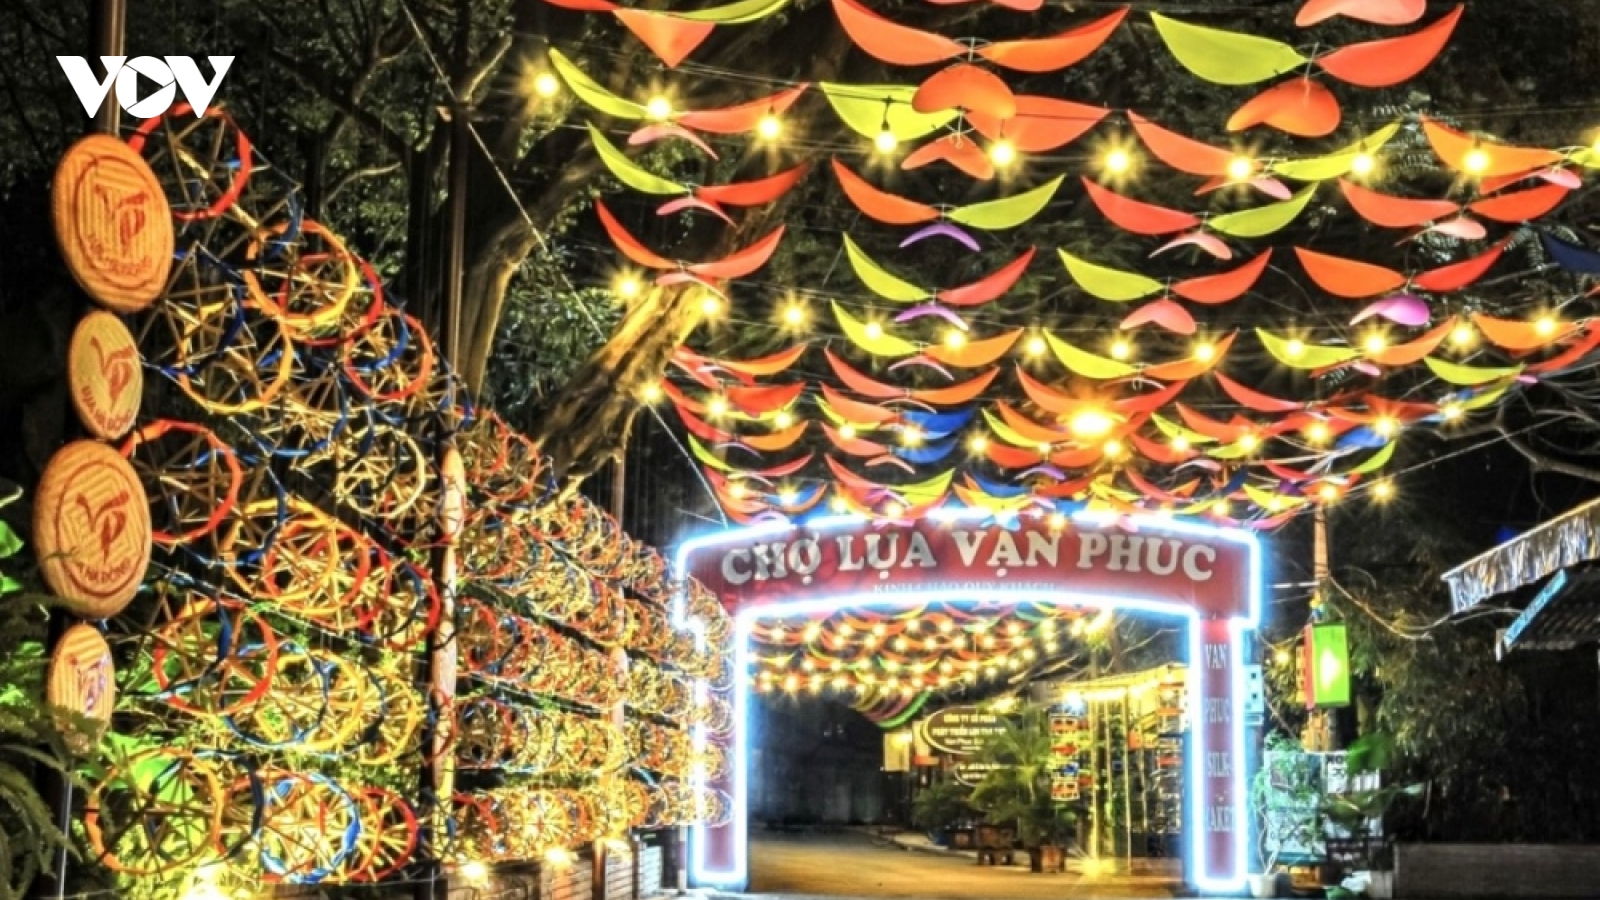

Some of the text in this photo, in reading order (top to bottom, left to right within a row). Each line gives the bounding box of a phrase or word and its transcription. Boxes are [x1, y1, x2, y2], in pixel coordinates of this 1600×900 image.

[721, 531, 822, 586] CHỢ
[836, 530, 937, 580] LỤA
[951, 529, 1063, 578] VẠN
